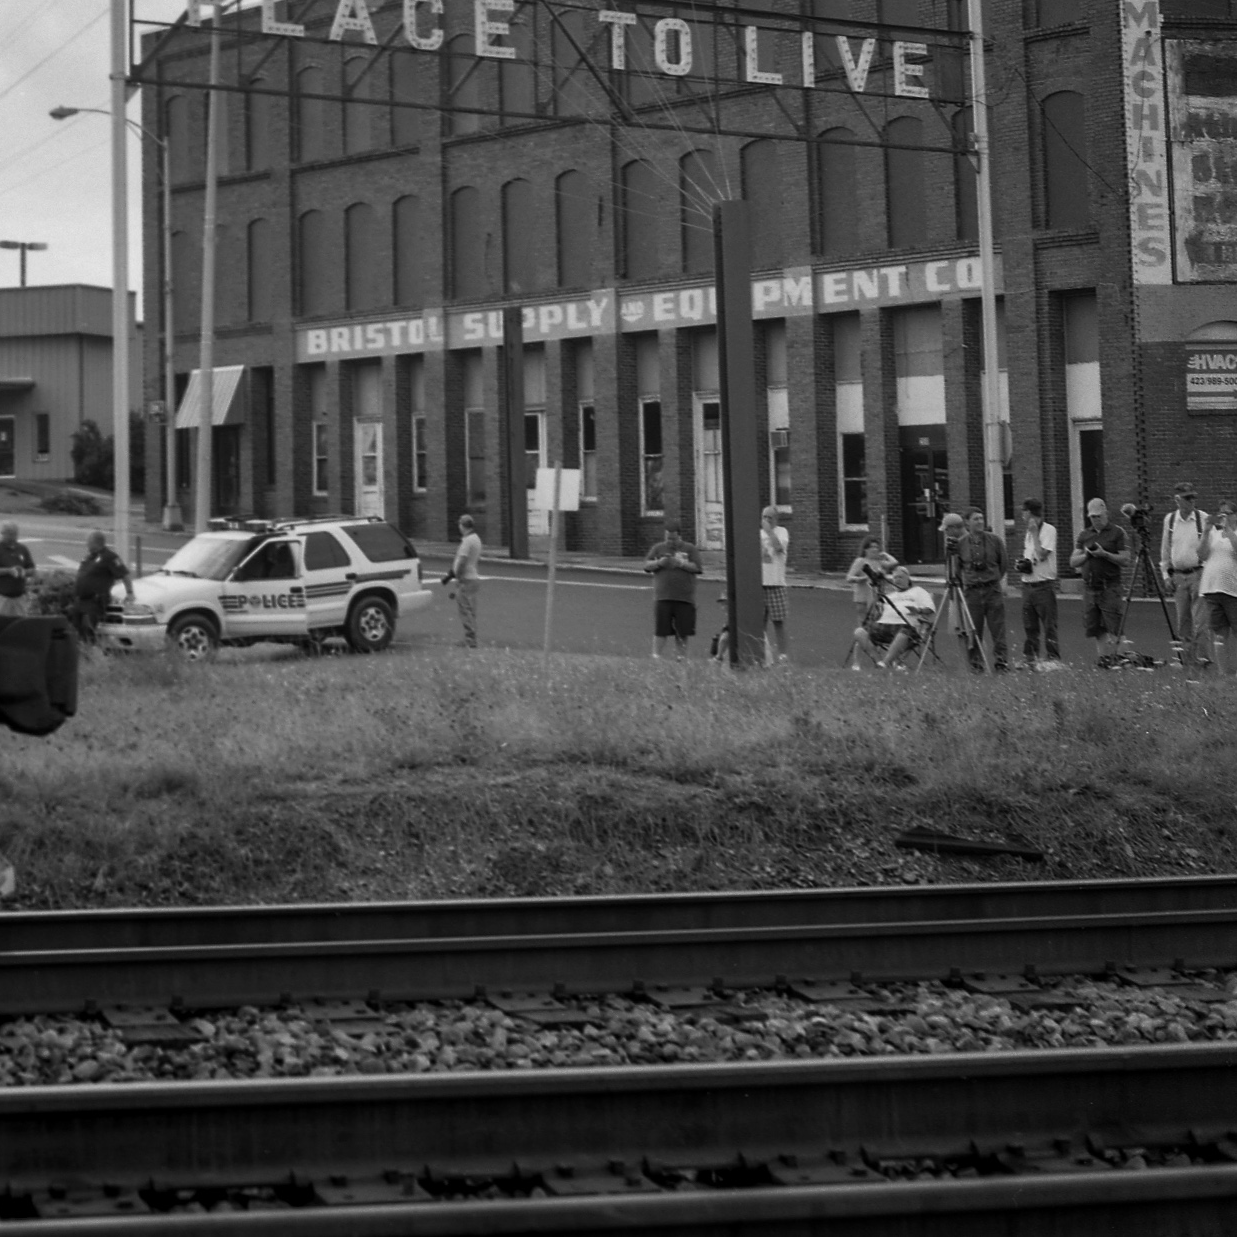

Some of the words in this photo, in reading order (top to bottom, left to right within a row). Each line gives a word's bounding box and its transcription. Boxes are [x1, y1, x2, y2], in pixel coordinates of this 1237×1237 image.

[598, 10, 691, 75] TO
[746, 24, 930, 98] LIVE
[1123, 1, 1166, 267] MACHINES
[307, 315, 444, 354] BRISTOL
[653, 266, 906, 321] EQPMENT
